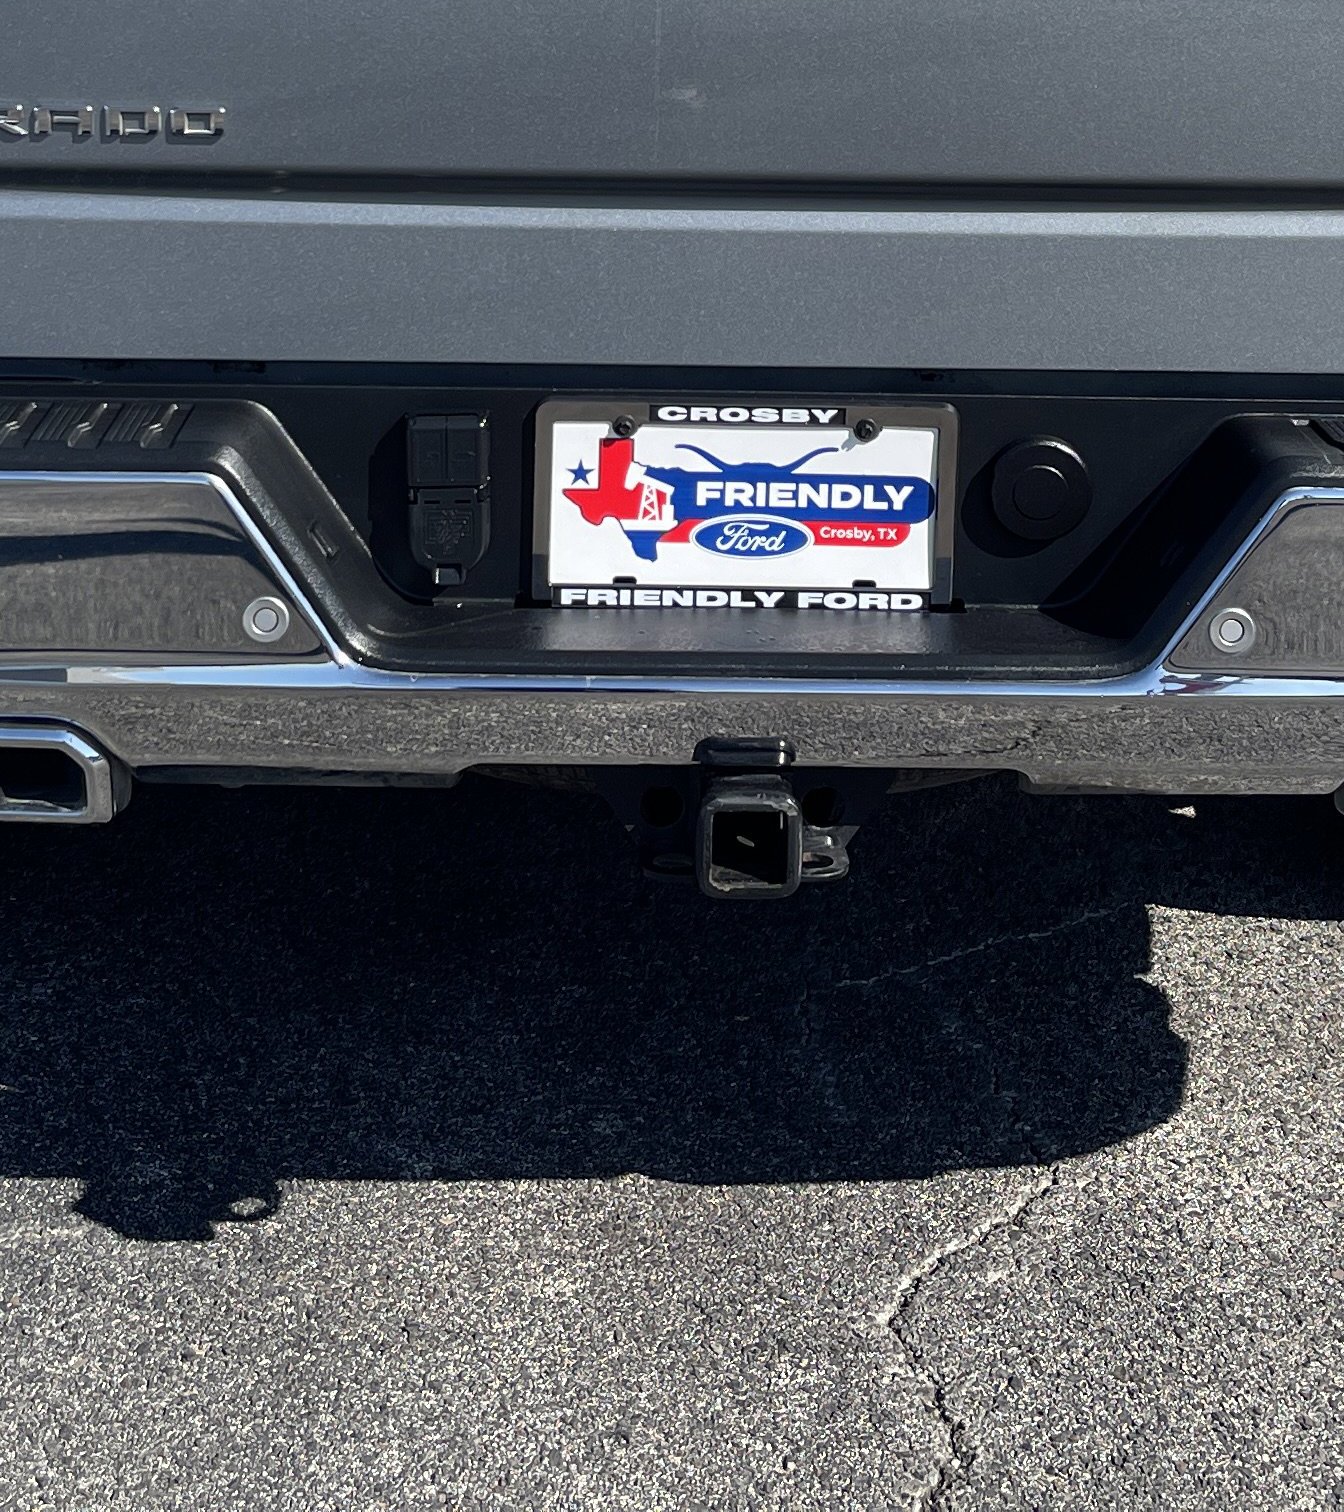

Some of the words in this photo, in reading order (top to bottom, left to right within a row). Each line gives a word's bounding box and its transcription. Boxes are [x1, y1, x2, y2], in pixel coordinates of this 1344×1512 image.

[657, 405, 839, 424] CROSBY
[696, 481, 915, 511] FRIENDLY
[716, 522, 787, 553] Ford
[819, 526, 875, 542] Crosby,
[877, 527, 898, 541] TX
[560, 588, 788, 609] FRIENDLY
[797, 592, 924, 610] FORD
